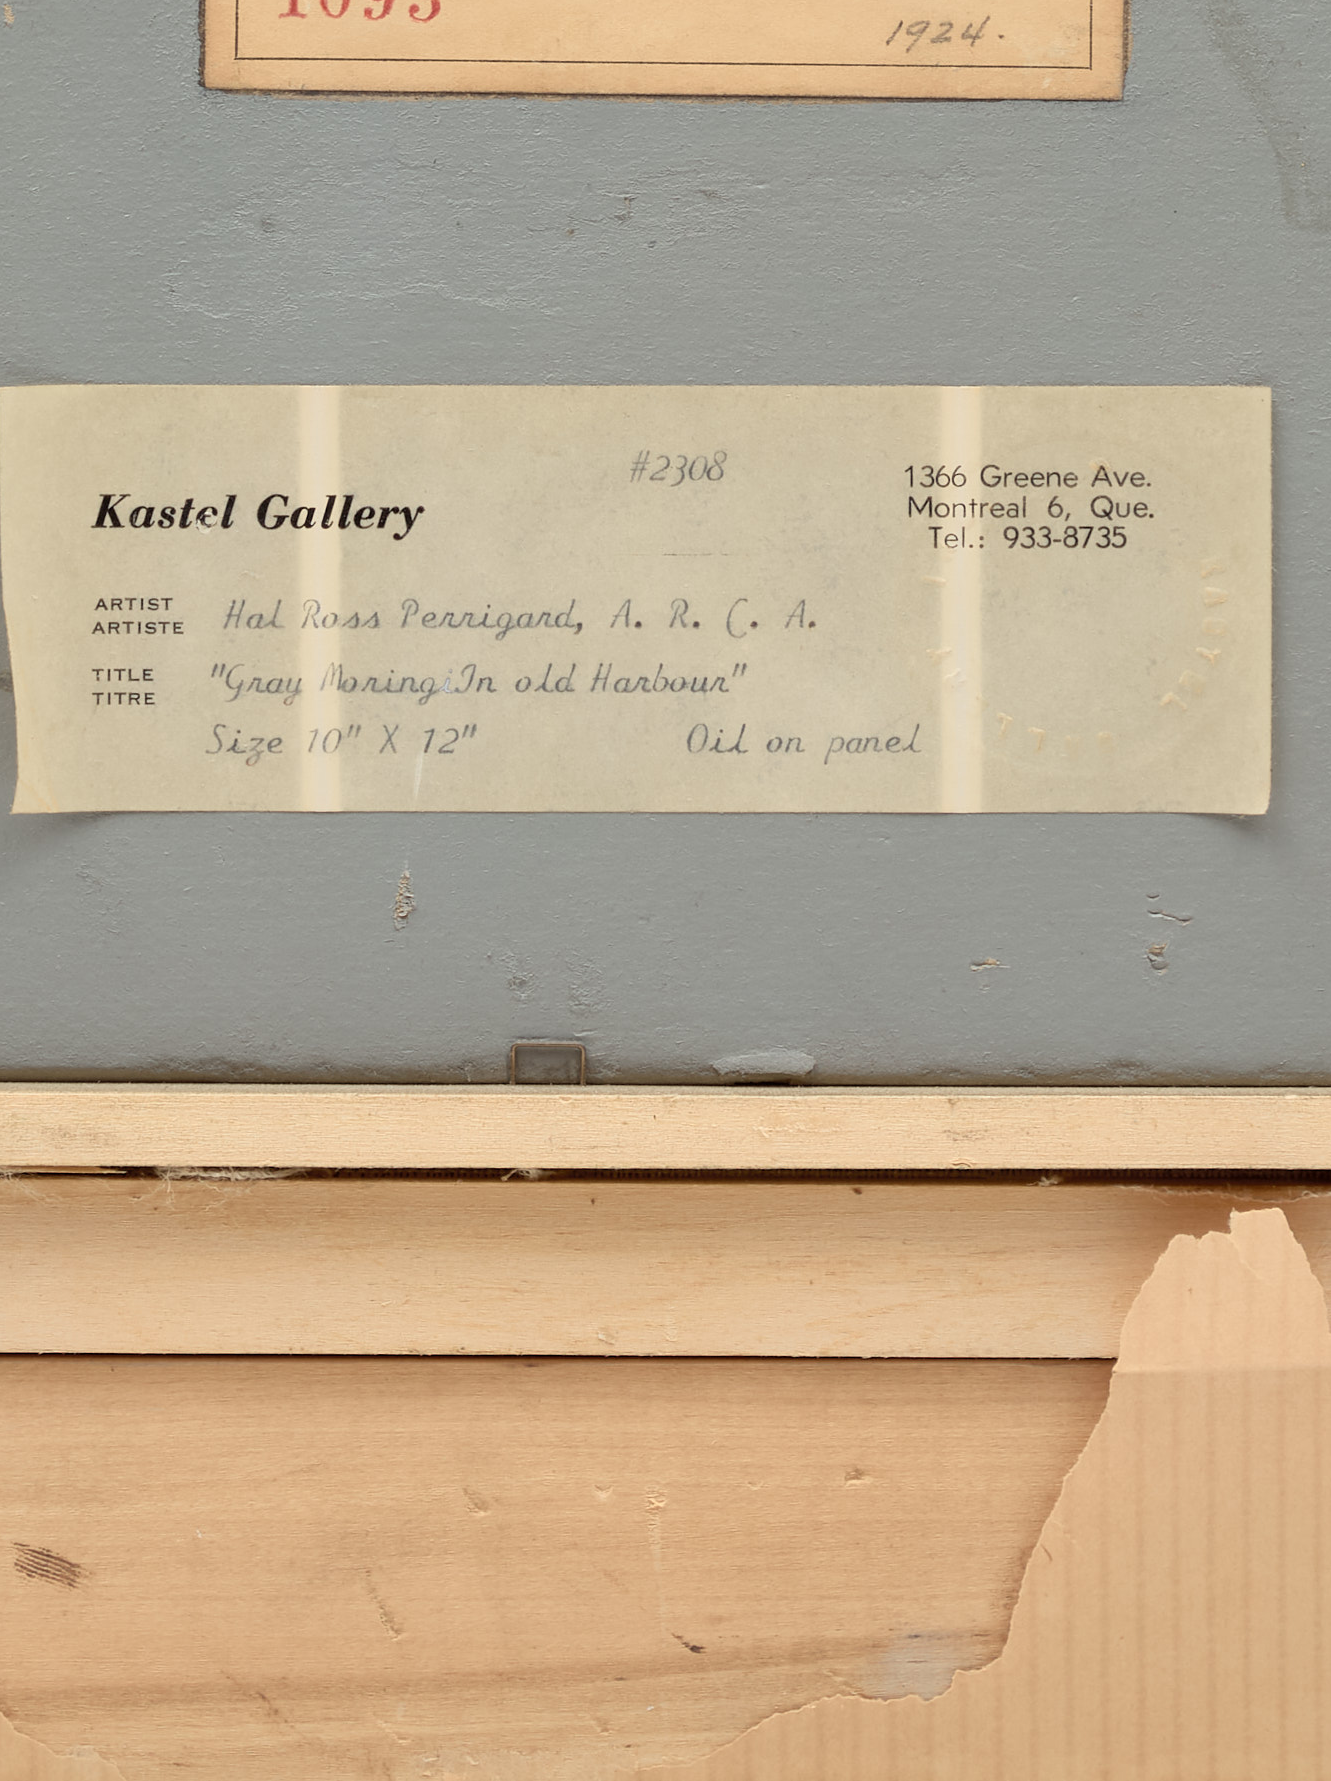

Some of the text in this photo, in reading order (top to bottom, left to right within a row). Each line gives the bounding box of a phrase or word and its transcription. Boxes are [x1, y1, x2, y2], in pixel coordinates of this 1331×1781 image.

[629, 449, 728, 487] #2308
[904, 463, 1153, 488] 1366 Greene Ave.
[91, 493, 426, 541] Kastel Gallery
[907, 494, 1155, 522] Montreal 6, Que.
[928, 525, 1128, 549] Tel.: 933-8735
[94, 597, 174, 612] ARTIST
[91, 621, 186, 636] ARTISTE
[223, 599, 285, 630] Hal
[300, 598, 382, 630] Ross
[400, 598, 583, 641] Perrigard,
[609, 598, 643, 629] A.
[669, 598, 701, 629] R.
[783, 598, 817, 629] A.
[91, 667, 155, 682] TITLE
[211, 663, 302, 706] "Gray
[514, 662, 577, 694] old
[589, 661, 748, 694] Harbour"
[91, 691, 157, 707] TITRE
[204, 722, 923, 767] Size 10" X 12" Oil on panel
